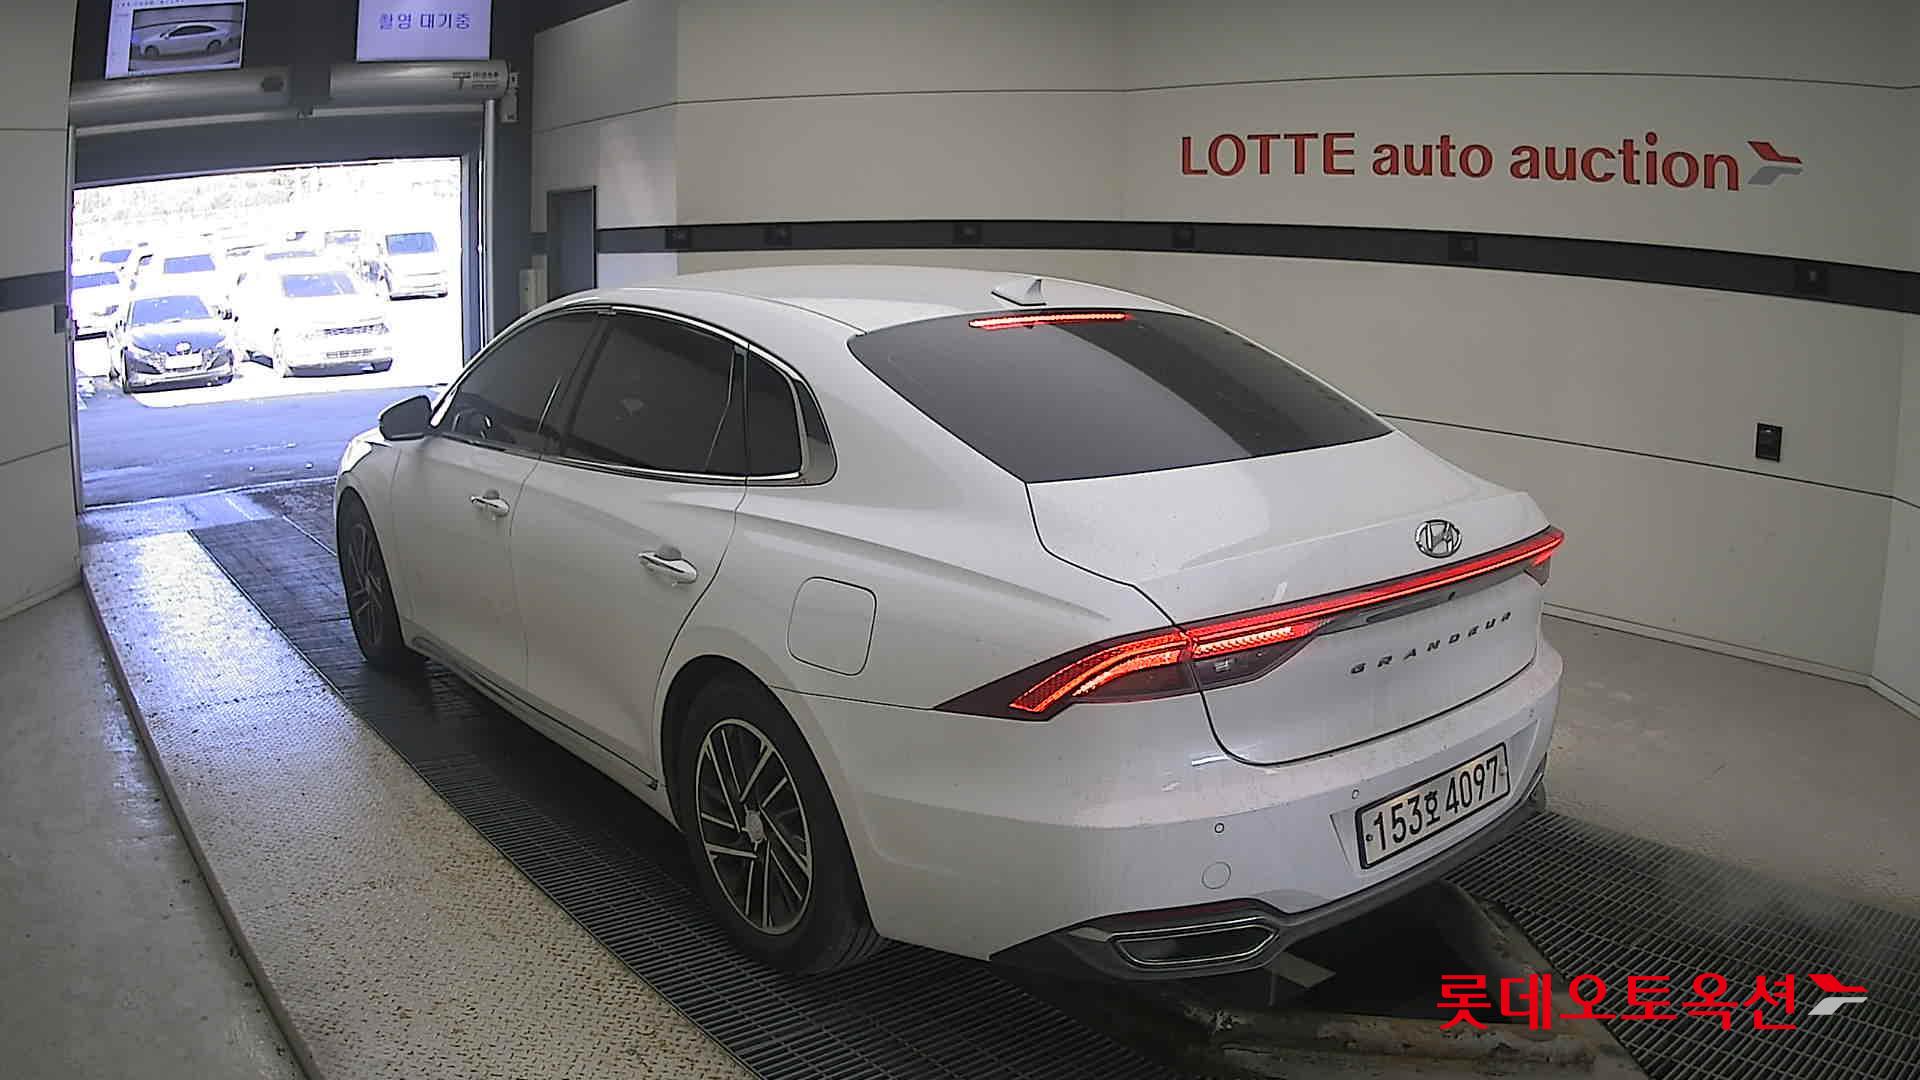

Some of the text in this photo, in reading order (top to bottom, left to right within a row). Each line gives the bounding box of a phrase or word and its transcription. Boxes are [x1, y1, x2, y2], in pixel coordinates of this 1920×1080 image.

[420, 13, 470, 30] 대기중
[1181, 131, 1742, 192] LOTTE auto auction
[1350, 611, 1512, 675] GRANDEUR
